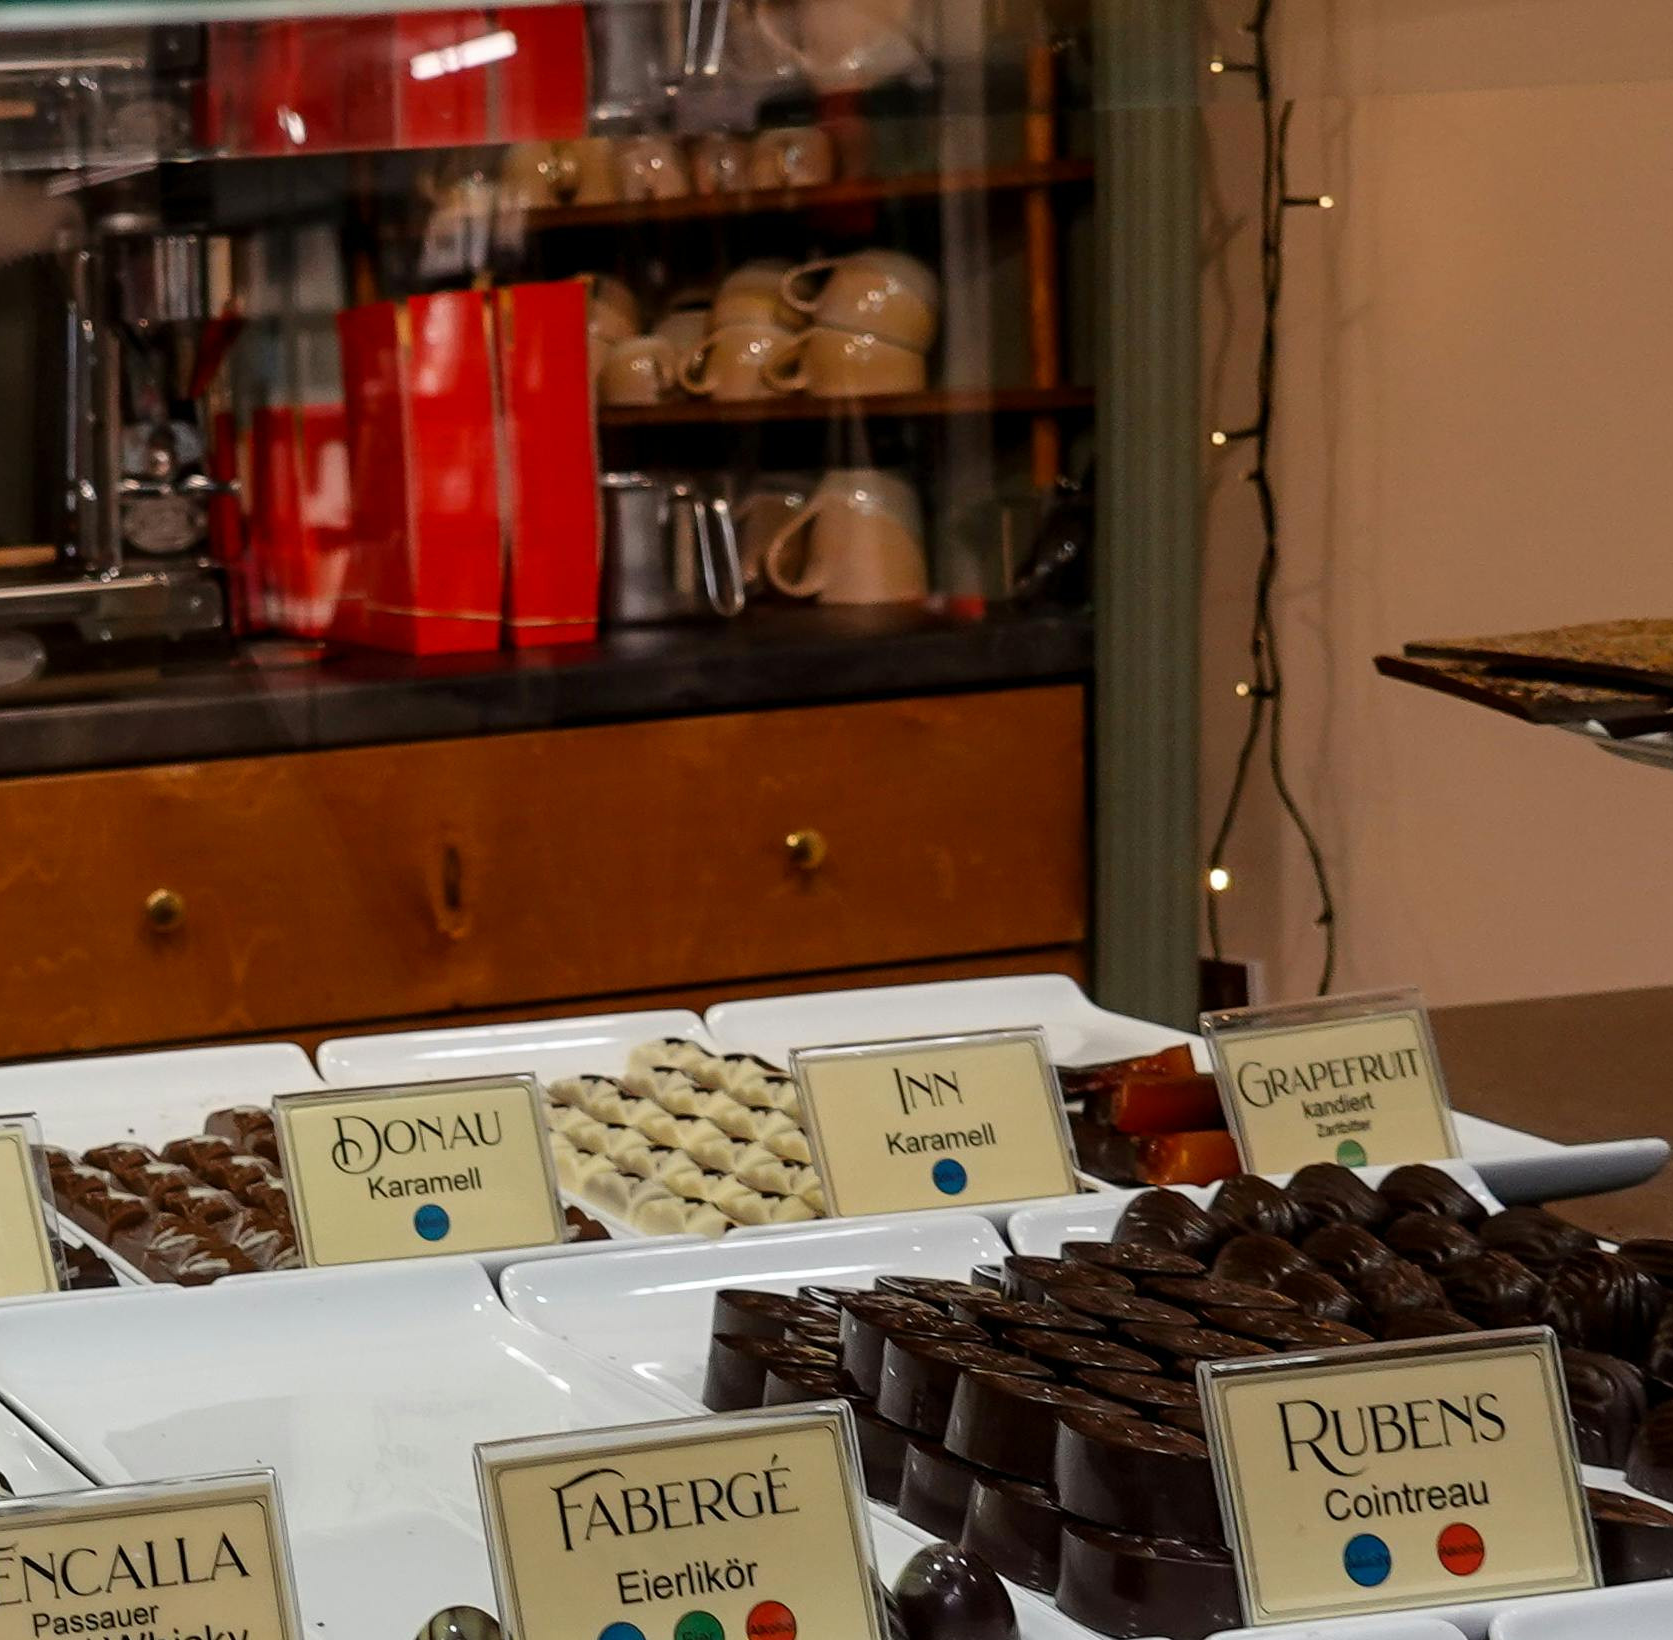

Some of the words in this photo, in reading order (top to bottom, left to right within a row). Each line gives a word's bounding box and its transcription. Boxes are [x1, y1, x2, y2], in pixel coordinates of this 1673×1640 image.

[891, 1066, 962, 1115] INN
[1237, 1048, 1421, 1108] GRAPEFRUIT
[1300, 1092, 1376, 1119] kandiert
[330, 1110, 504, 1176] DONAU
[884, 1122, 997, 1157] Karamell
[367, 1167, 482, 1202] Karamell
[1275, 1391, 1507, 1479] RUBENS
[549, 1453, 801, 1552] FABERGÉ
[1324, 1479, 1491, 1522] Cointreau
[616, 1559, 759, 1605] Eierlikör
[32, 1604, 160, 1639] Passauer
